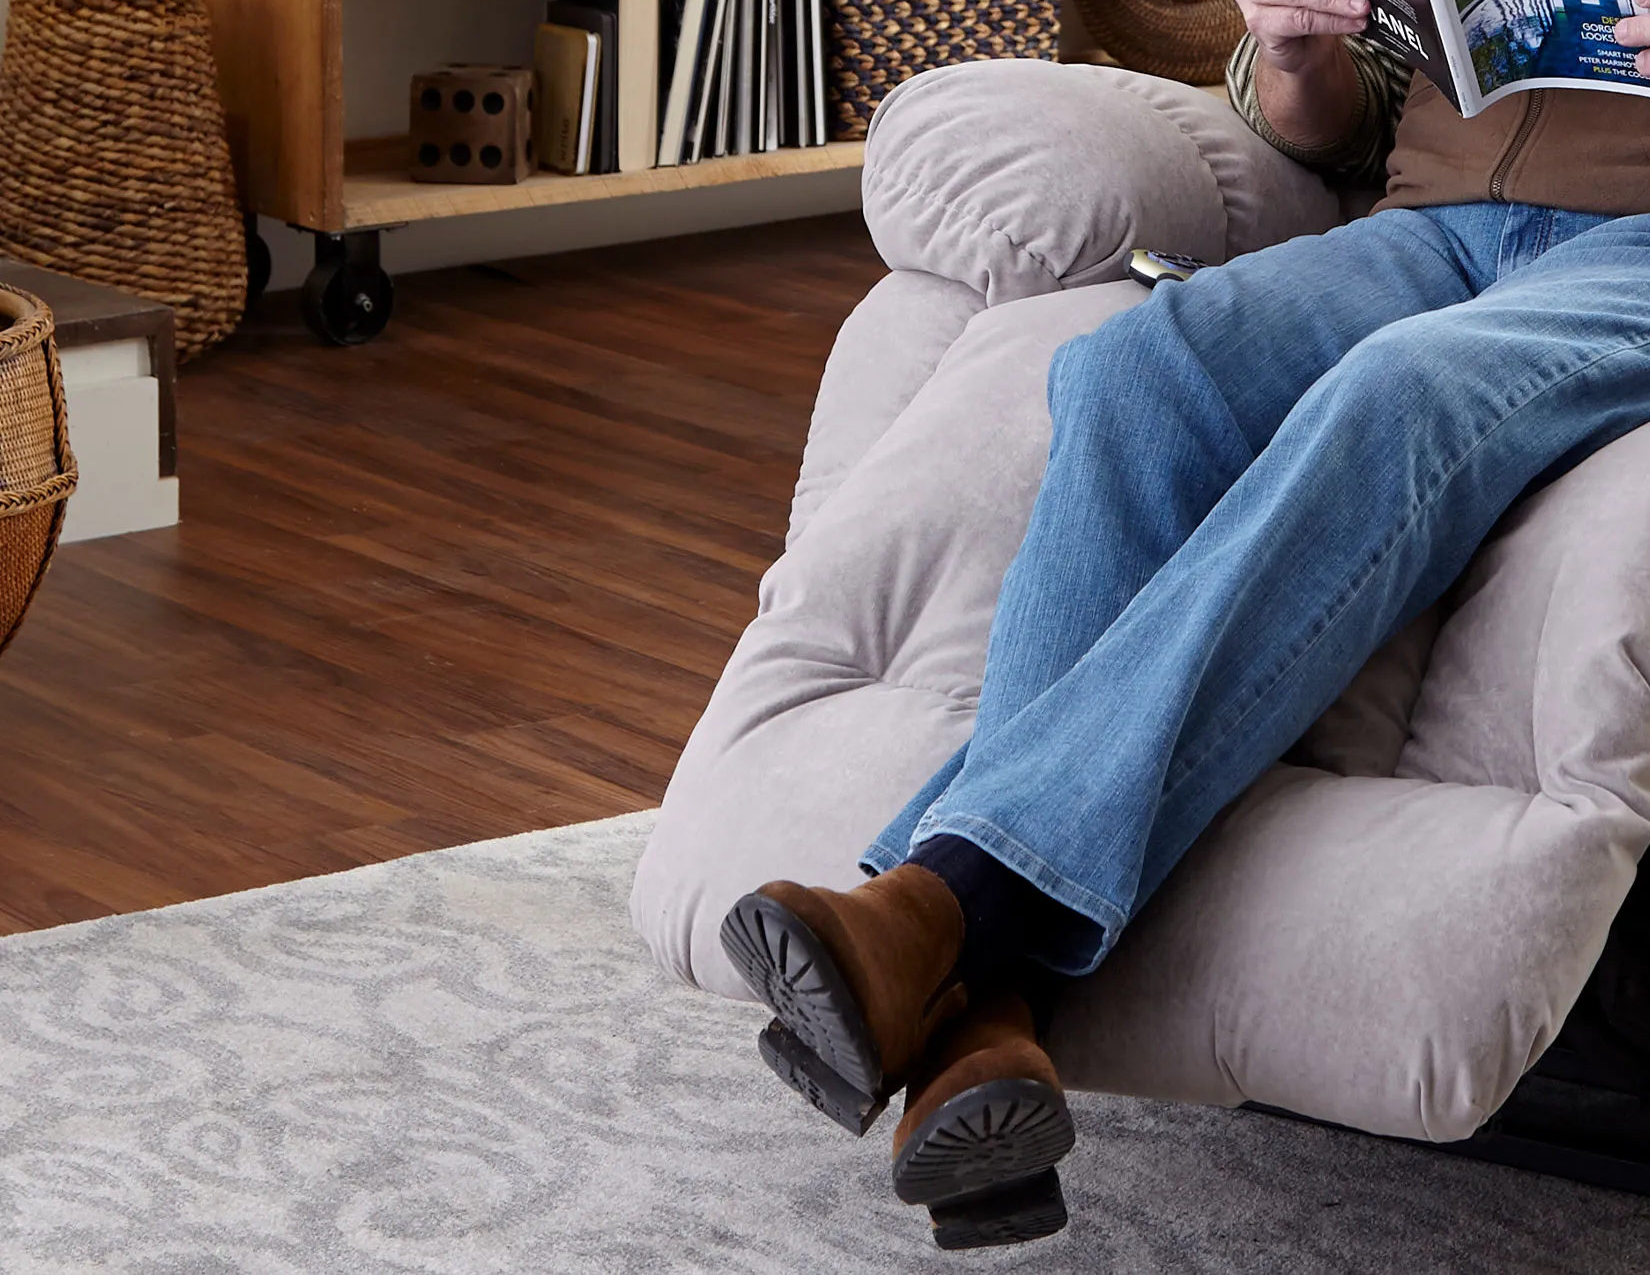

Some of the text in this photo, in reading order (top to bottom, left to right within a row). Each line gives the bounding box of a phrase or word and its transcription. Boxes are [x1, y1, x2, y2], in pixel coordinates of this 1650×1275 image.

[1371, 6, 1430, 61] ANEL
[1597, 49, 1621, 57] SMART
[1579, 56, 1601, 64] PETER
[1612, 68, 1628, 77] THE
